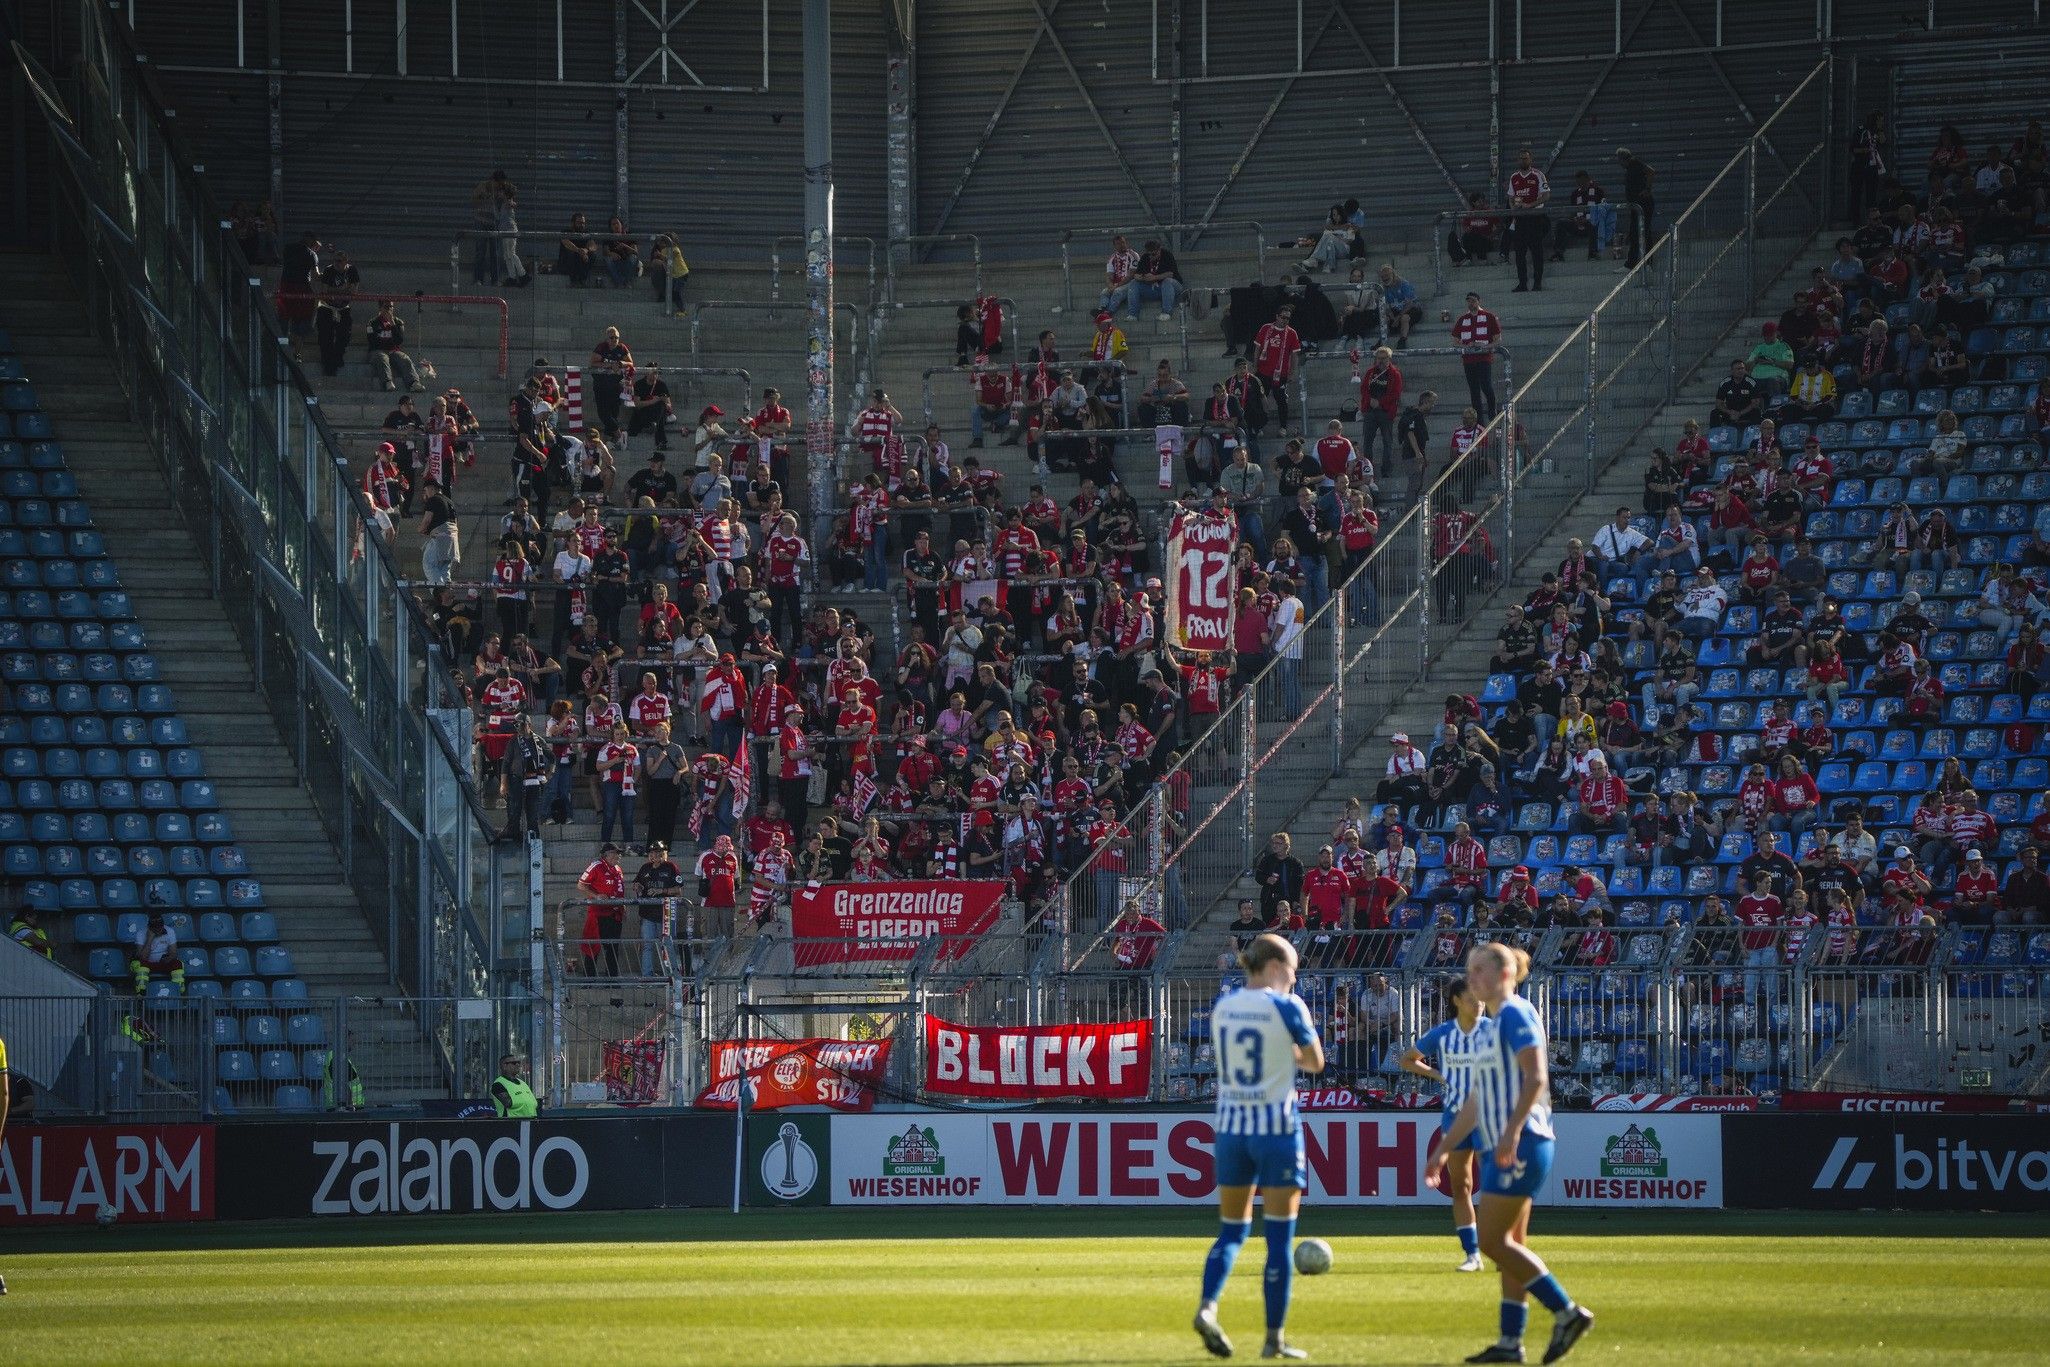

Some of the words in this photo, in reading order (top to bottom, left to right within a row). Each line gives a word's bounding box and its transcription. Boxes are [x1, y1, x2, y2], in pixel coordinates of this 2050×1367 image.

[503, 566, 513, 582] 9
[1180, 549, 1228, 608] 12
[645, 712, 662, 720] BERLIN
[834, 889, 964, 917] Grenzenlos
[814, 1043, 879, 1071] UNSER
[936, 1029, 1096, 1085] BLOCK
[1108, 1033, 1138, 1085] F
[1219, 1026, 1264, 1087] 13
[312, 1120, 589, 1214] zalando
[894, 1165, 934, 1174] ORIGINAL
[992, 1121, 1480, 1197] WIESNH
[1612, 1166, 1656, 1176] ORIGINAL
[848, 1177, 981, 1197] WIESENHOF
[1563, 1178, 1707, 1199] WIESENHOF
